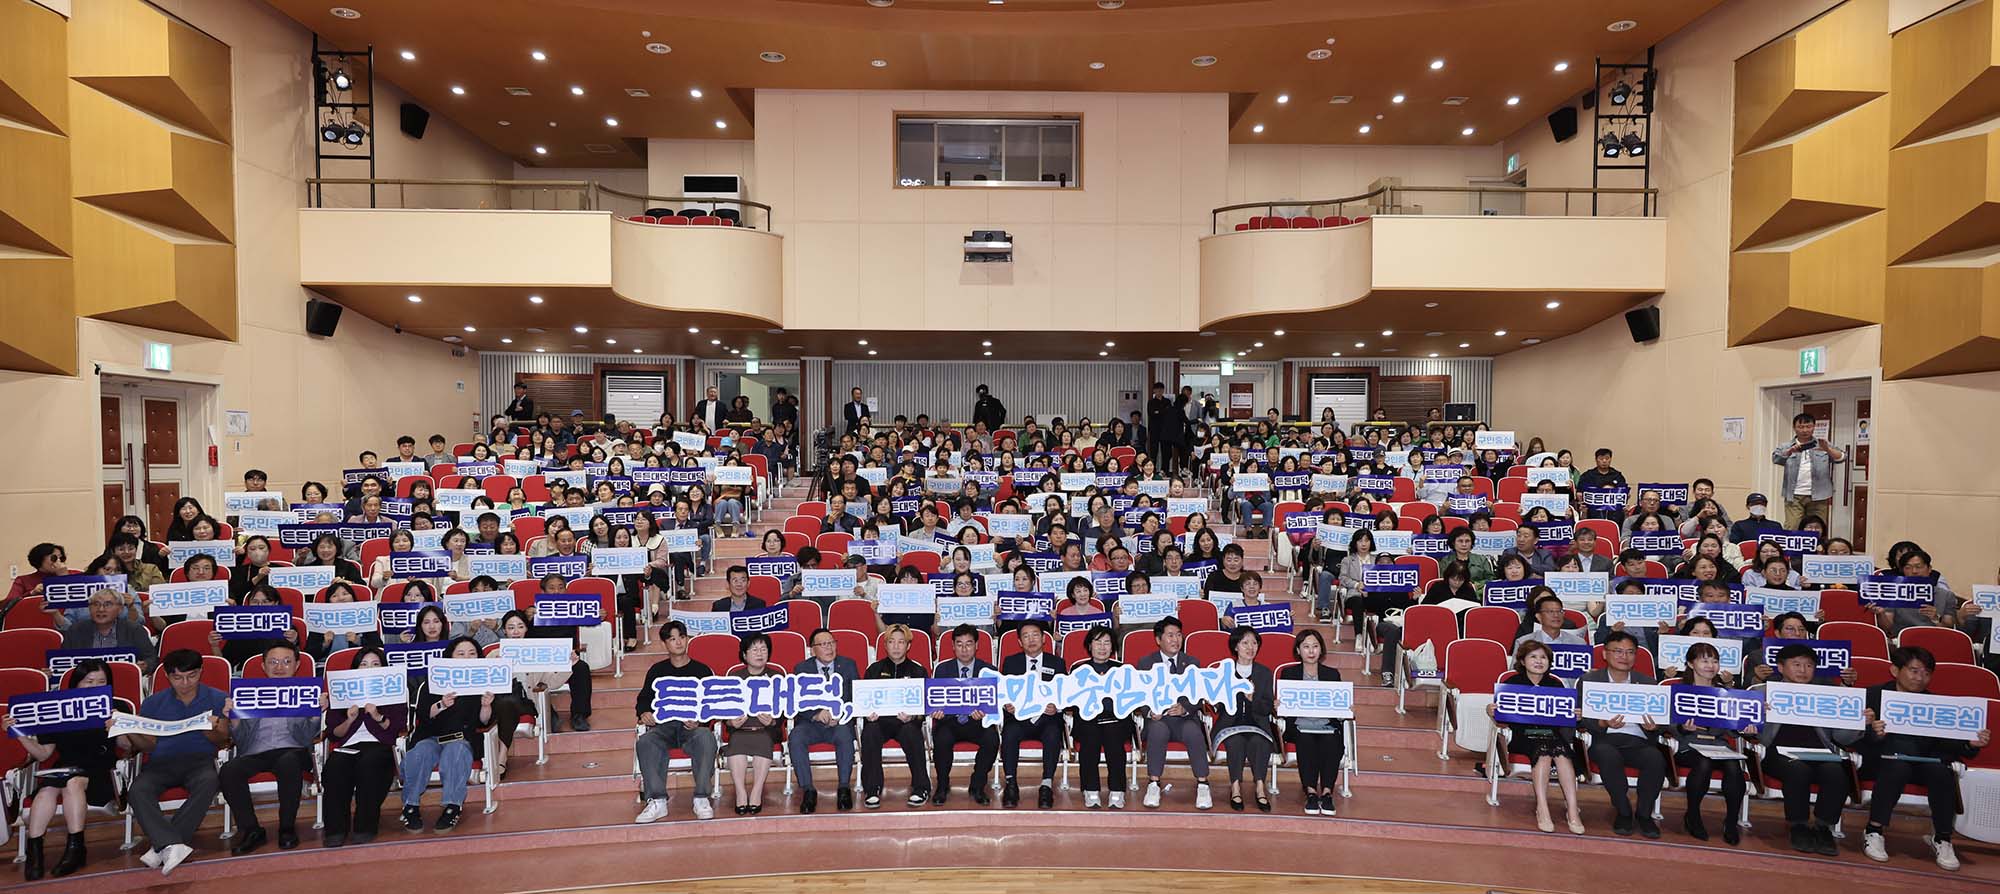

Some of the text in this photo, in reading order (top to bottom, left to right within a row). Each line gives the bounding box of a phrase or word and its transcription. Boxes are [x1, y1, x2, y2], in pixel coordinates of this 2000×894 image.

[458, 466, 496, 476] 든든대덕
[633, 471, 669, 481] 든든대덕
[671, 471, 705, 482] 든든대덕
[1425, 469, 1462, 480] 든든대덕
[1530, 471, 1567, 481] 구민중심
[1275, 475, 1309, 486] 든든대덕
[1359, 479, 1393, 489] 든든대덕
[440, 495, 474, 505] 구민중
[1449, 497, 1487, 510] 든든대덕
[1583, 491, 1627, 505] 든든대덕
[1170, 503, 1205, 513] 구민중심
[990, 520, 1030, 533] 구민중심
[1319, 529, 1350, 545] 구민중
[1631, 536, 1684, 550] 든든대덕
[1413, 539, 1451, 553] 든든대
[393, 556, 451, 573] 든든대덕
[471, 561, 525, 575] 구민중심
[532, 561, 586, 577] 든든대덕
[594, 552, 645, 569] 구민중심
[748, 562, 798, 577] 든든대덕
[1364, 570, 1418, 586] 든든대덕
[1805, 561, 1873, 579] 구민중심
[271, 571, 332, 587] 구민중심
[805, 576, 854, 592] 구민중심
[1549, 578, 1606, 595] 구민중심
[152, 586, 226, 609] 구민중심
[879, 590, 933, 607] 구민중심
[1859, 582, 1933, 602] 든든대덕
[447, 597, 514, 617] 구민중심
[537, 600, 600, 619] 든든대덕
[940, 603, 995, 620] 구민중심
[1000, 599, 1052, 615] 든든대덕
[1123, 601, 1176, 618] 구민중심
[1609, 601, 1675, 619] 구민중심
[216, 613, 290, 632] 든든대덕
[306, 608, 375, 628] 구민중심
[732, 608, 788, 631] 든든대덕
[1234, 609, 1291, 627] 든든대덕
[502, 645, 571, 665] 구민중심
[431, 665, 511, 688] 구민중심
[330, 674, 405, 700] 구민중심
[1067, 661, 1250, 716] 중심입니다
[232, 686, 321, 708] 든든대덕
[654, 677, 853, 724] 든든대덕,
[863, 686, 921, 707] 구민중심
[927, 686, 997, 707] 든든대덕
[1280, 687, 1351, 711] 구민중심
[1497, 692, 1576, 718] 든든대덕
[1586, 690, 1668, 716] 구민중심
[10, 695, 111, 728] 든든대덕
[1675, 692, 1762, 723] 든든대덕
[1770, 691, 1862, 720] 구민중심
[1885, 701, 1983, 731] 구민중심
